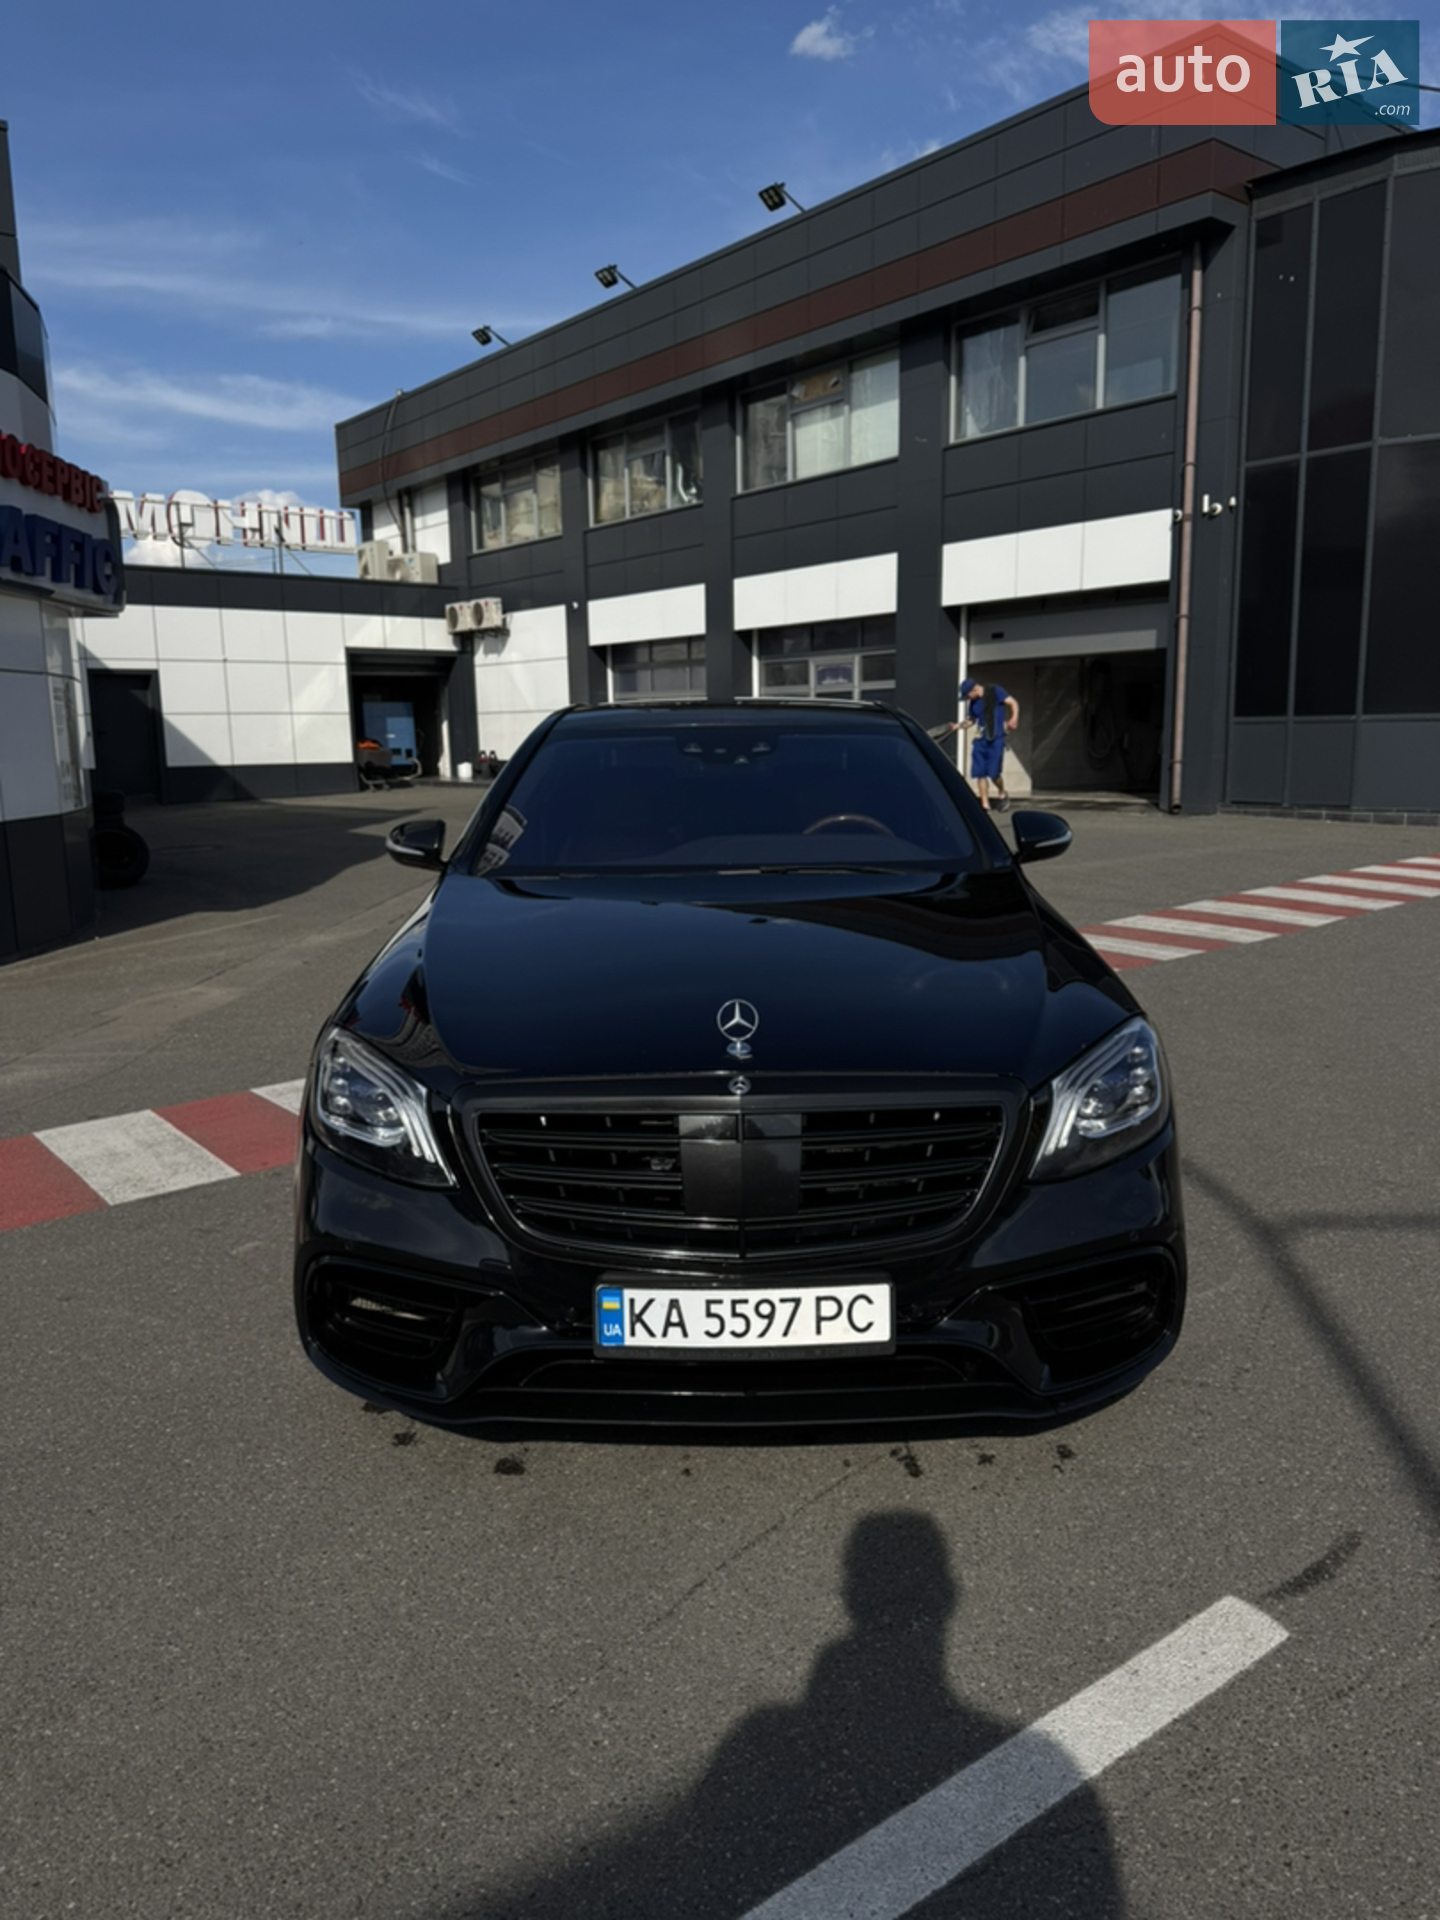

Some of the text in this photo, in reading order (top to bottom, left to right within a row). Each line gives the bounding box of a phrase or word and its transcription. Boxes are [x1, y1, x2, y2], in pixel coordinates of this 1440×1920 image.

[0, 432, 104, 513] ОСЕРВІС
[603, 1324, 622, 1336] UA
[629, 1294, 874, 1338] KA 5597 PC
